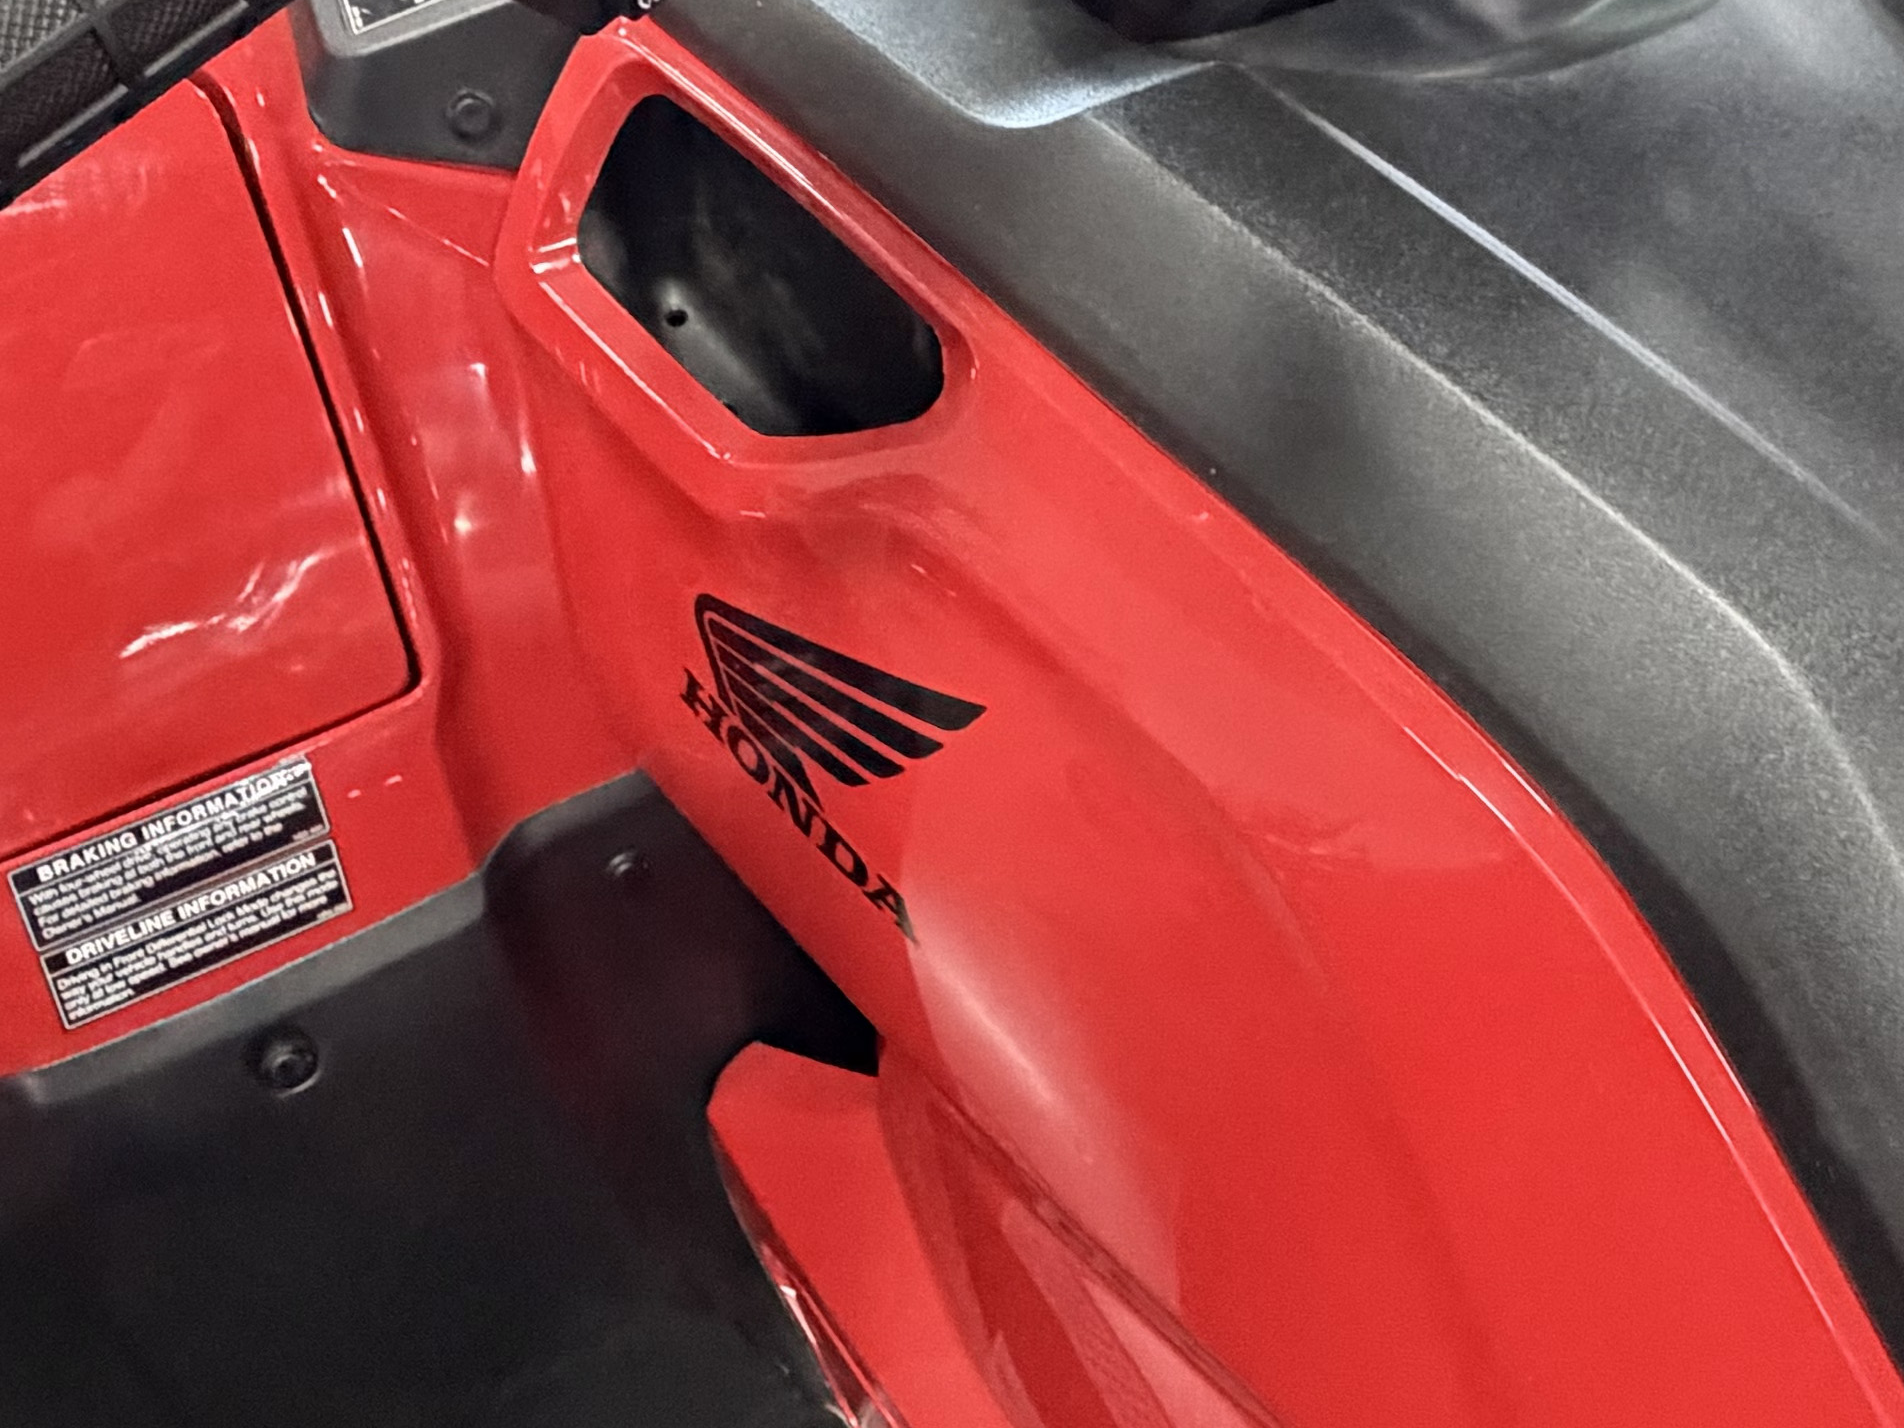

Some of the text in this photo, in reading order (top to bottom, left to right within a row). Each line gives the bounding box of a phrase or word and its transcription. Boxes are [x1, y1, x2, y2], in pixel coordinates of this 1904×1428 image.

[35, 767, 289, 883] BRAKING INFORMATION
[679, 667, 918, 945] HONDA
[65, 851, 316, 965] DRIVELINE INFORMATION
